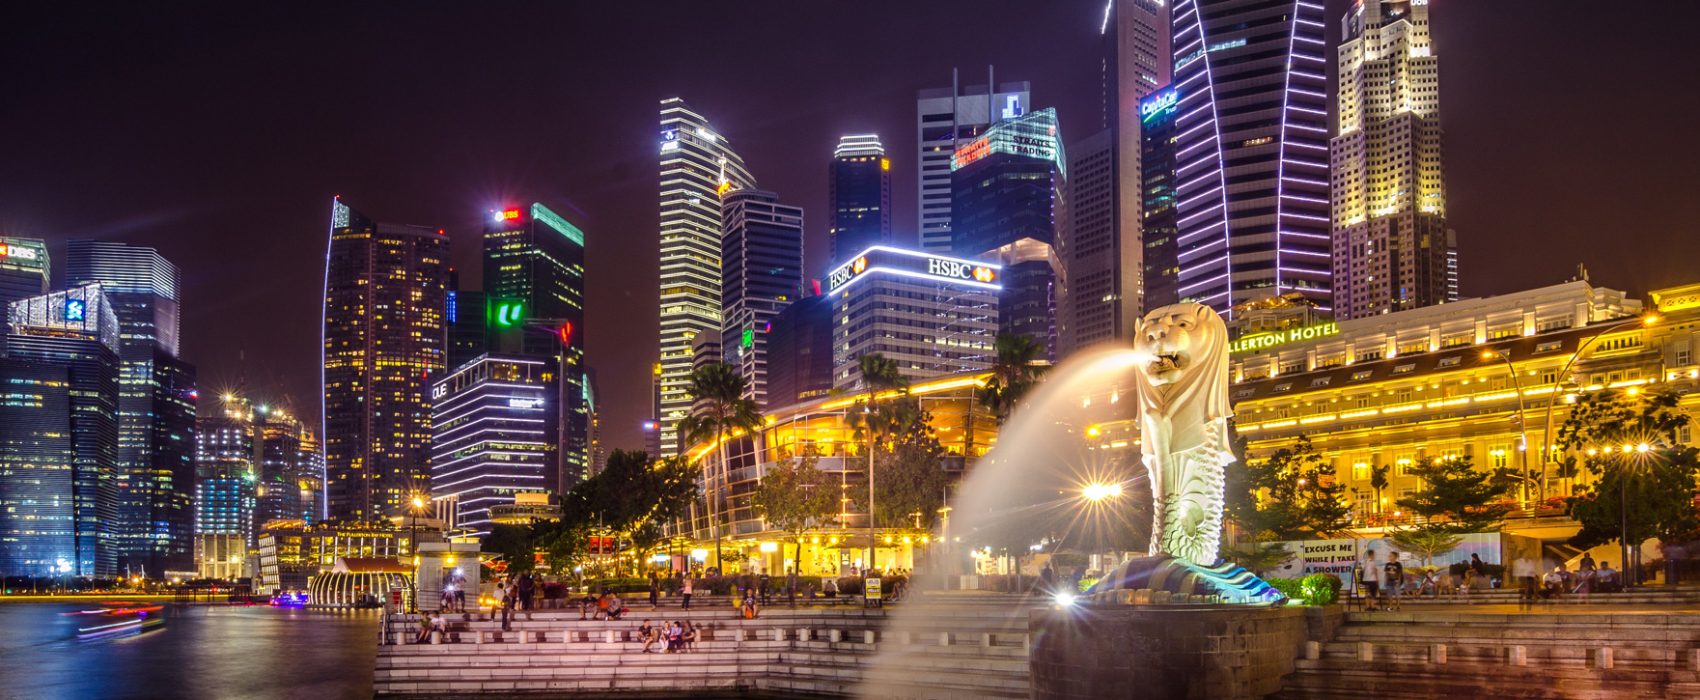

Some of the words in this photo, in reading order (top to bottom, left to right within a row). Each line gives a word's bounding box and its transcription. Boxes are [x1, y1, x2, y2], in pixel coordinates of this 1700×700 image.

[1013, 135, 1050, 147] STRAITS
[1011, 145, 1051, 157] TRADING
[8, 245, 36, 260] DBS
[928, 258, 971, 279] HSBC
[829, 263, 853, 290] HSBC
[1290, 322, 1340, 342] HOTEL
[1339, 544, 1352, 552] ME
[1305, 566, 1311, 574] A
[1313, 565, 1352, 574] SHOWER
